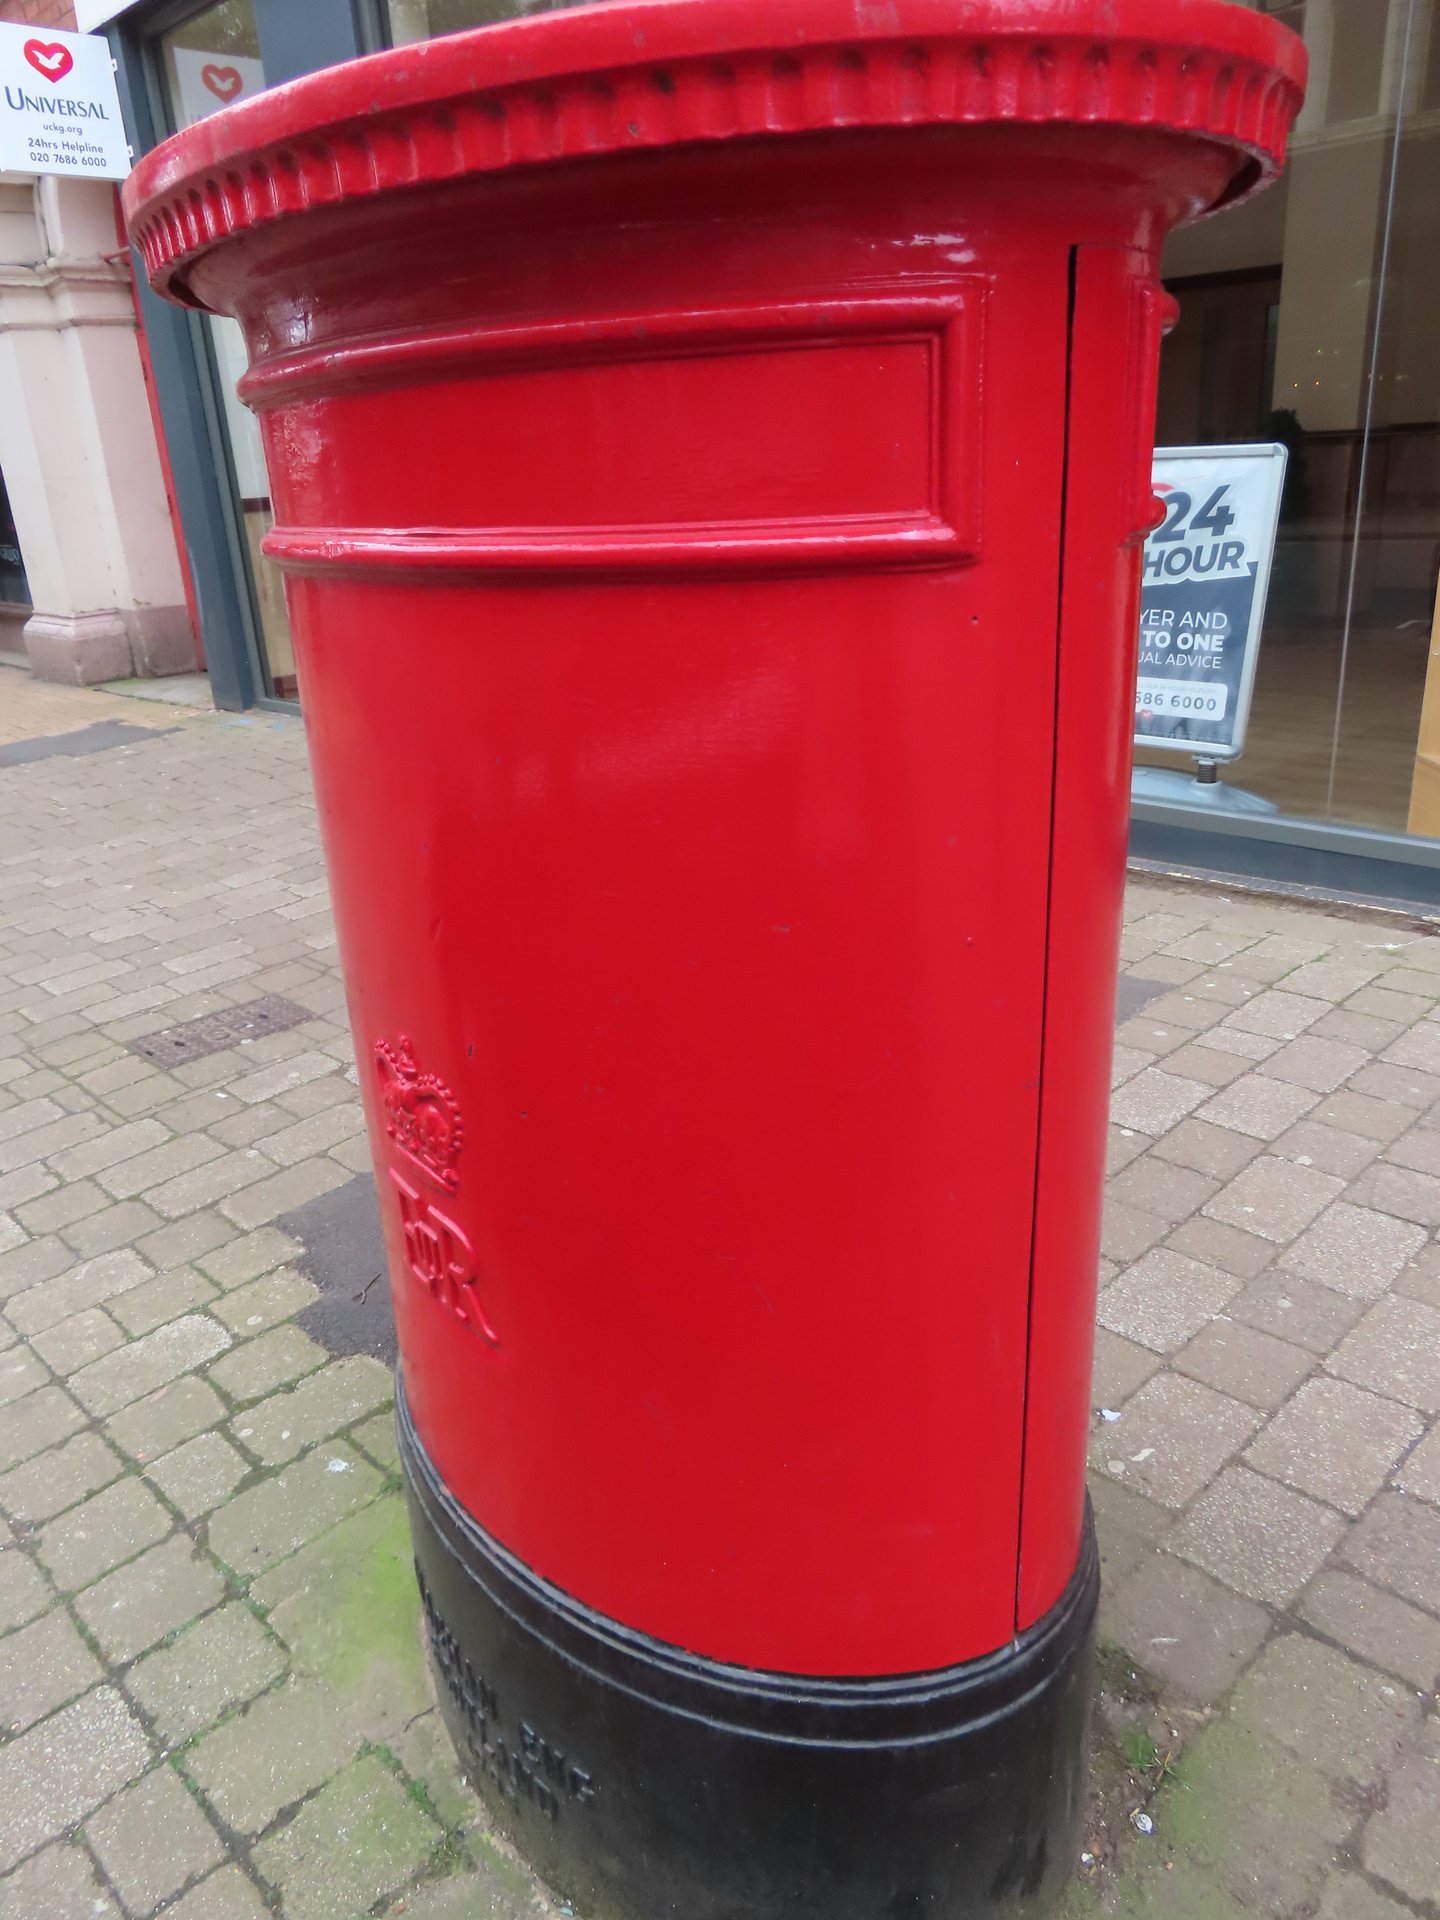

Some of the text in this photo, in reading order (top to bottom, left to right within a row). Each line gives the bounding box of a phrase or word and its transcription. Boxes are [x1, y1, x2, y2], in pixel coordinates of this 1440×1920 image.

[4, 85, 110, 121] UNIVERSAL
[42, 122, 84, 136] uckg.org
[28, 137, 104, 154] 24hrs Helpline
[30, 151, 107, 167] 020 7686 6000
[1152, 485, 1235, 544] 24
[1143, 541, 1245, 578] HOUR
[1178, 611, 1228, 629] AND
[1142, 630, 1224, 652] TO ONE
[1165, 653, 1222, 669] ADVICE
[1170, 695, 1217, 711] 6000
